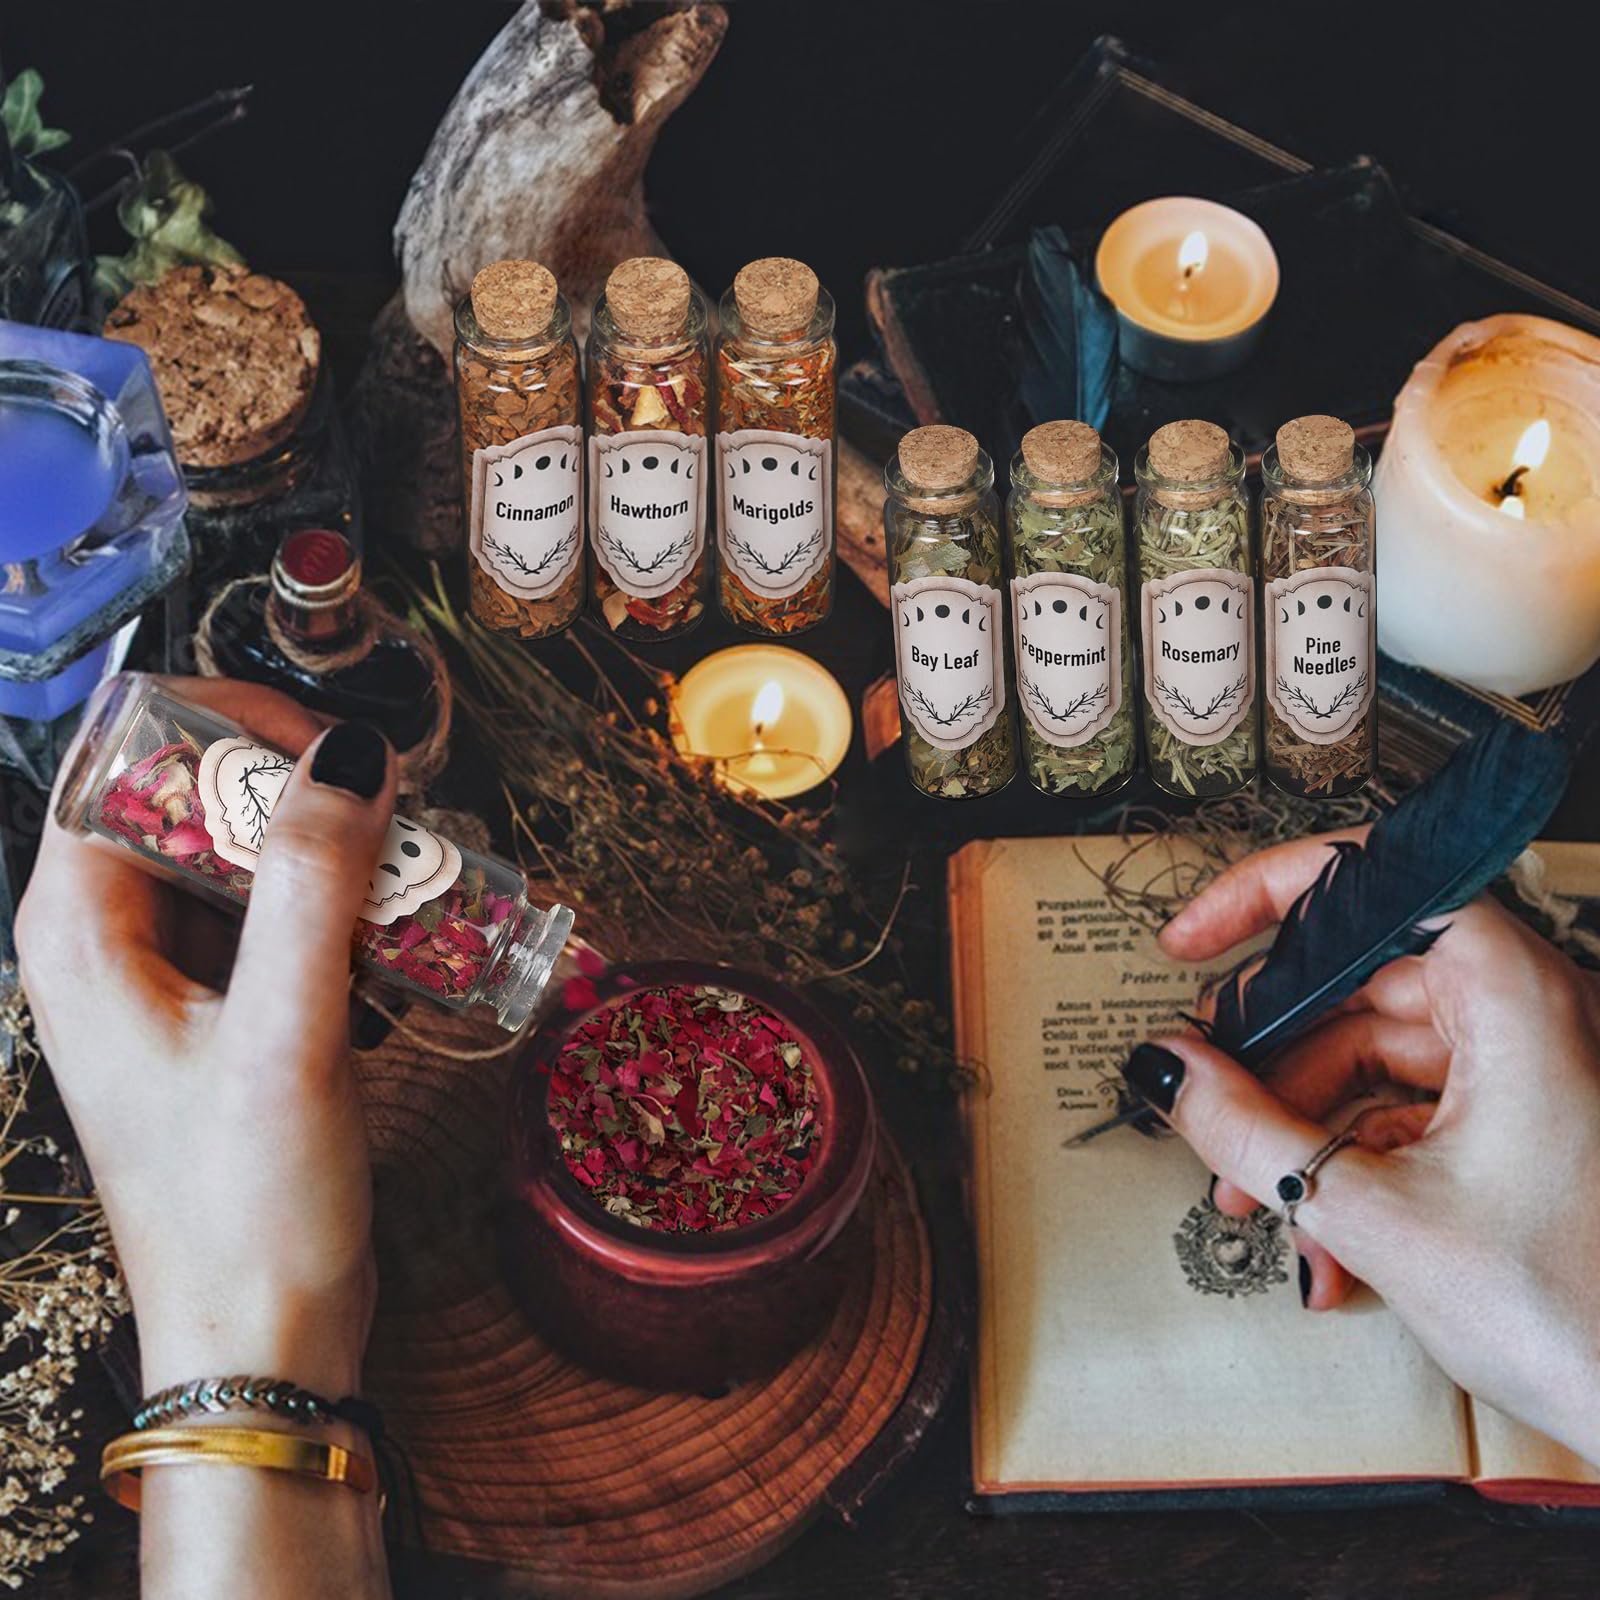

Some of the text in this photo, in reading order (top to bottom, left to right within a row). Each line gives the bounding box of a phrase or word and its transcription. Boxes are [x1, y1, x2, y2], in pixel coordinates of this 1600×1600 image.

[495, 493, 575, 522] Cinnamon
[610, 494, 689, 520] Hawthorn
[732, 494, 815, 525] Marigolds
[911, 645, 979, 672] Bay Leaf
[1020, 633, 1107, 668] Peppermint
[1161, 640, 1241, 664] Rosemary
[1305, 636, 1342, 656] Pine
[1293, 655, 1358, 676] Needles
